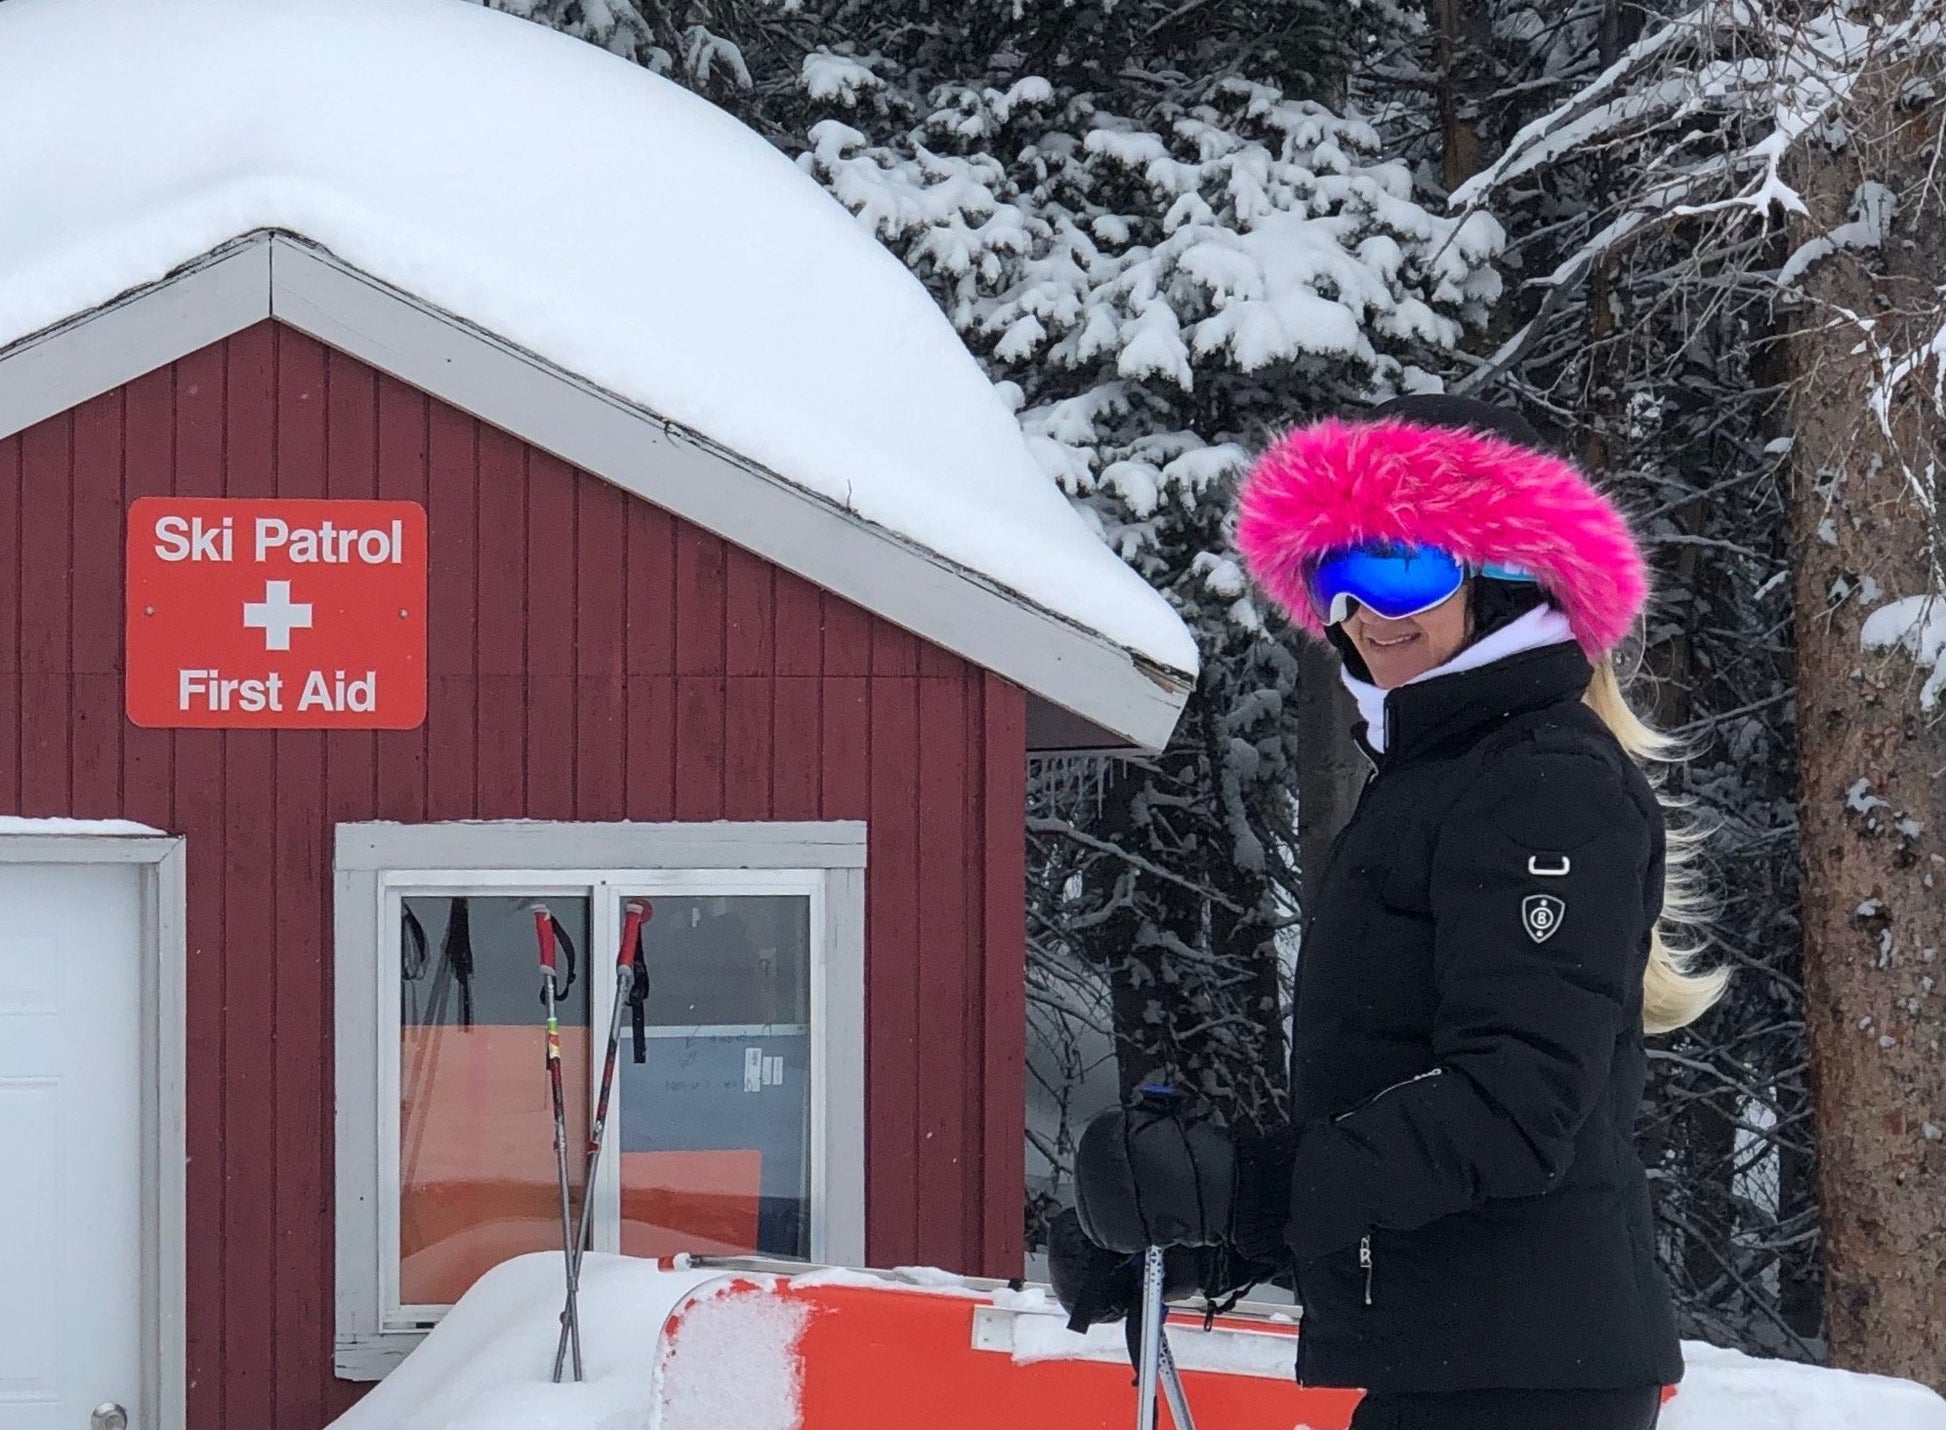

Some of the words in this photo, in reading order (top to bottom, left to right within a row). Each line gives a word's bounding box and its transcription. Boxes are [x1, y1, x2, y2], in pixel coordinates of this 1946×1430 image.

[154, 515, 233, 562] Ski
[255, 517, 402, 564] Patrol
[179, 668, 283, 712] First
[297, 670, 377, 713] Aid
